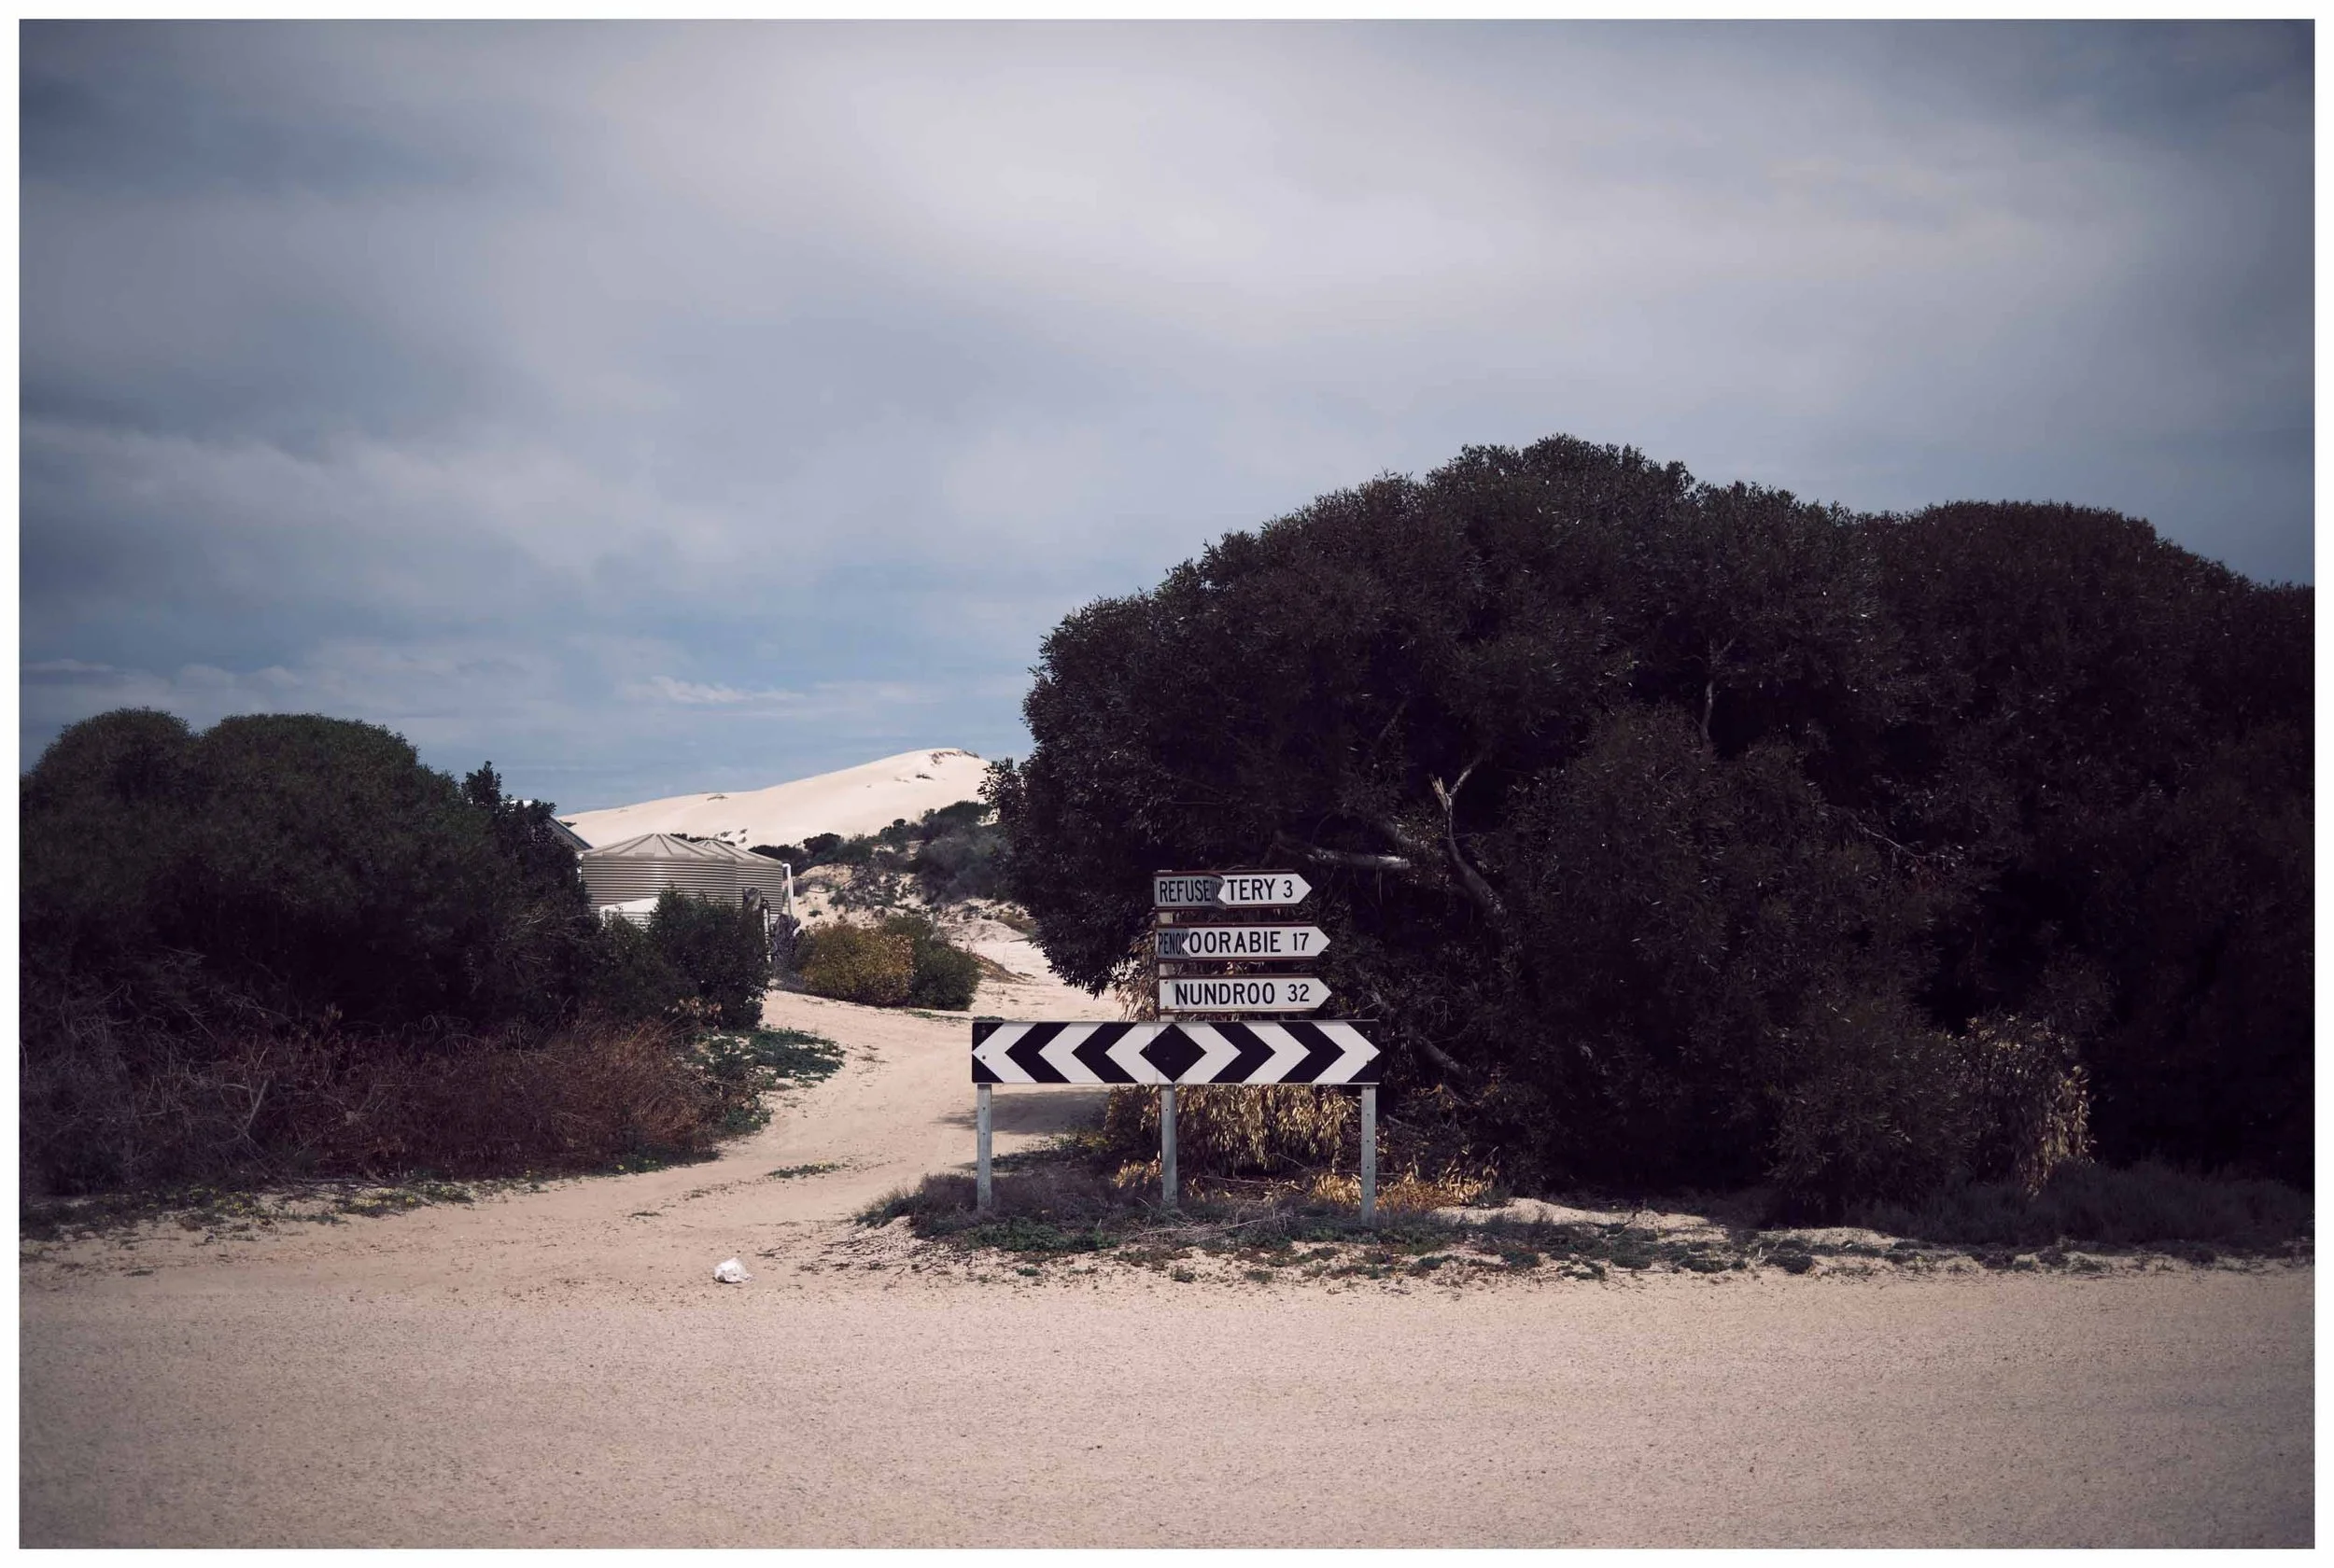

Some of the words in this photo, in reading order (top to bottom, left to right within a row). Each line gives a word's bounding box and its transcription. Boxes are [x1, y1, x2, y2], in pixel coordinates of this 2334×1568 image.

[1160, 879, 1211, 903] REFUSE
[1227, 878, 1276, 901] TERY
[1283, 879, 1293, 899] 3
[1188, 931, 1281, 954] OORABIE
[1292, 932, 1310, 951] 17
[1174, 982, 1275, 1005] NUNDROO
[1287, 983, 1310, 1002] 32
